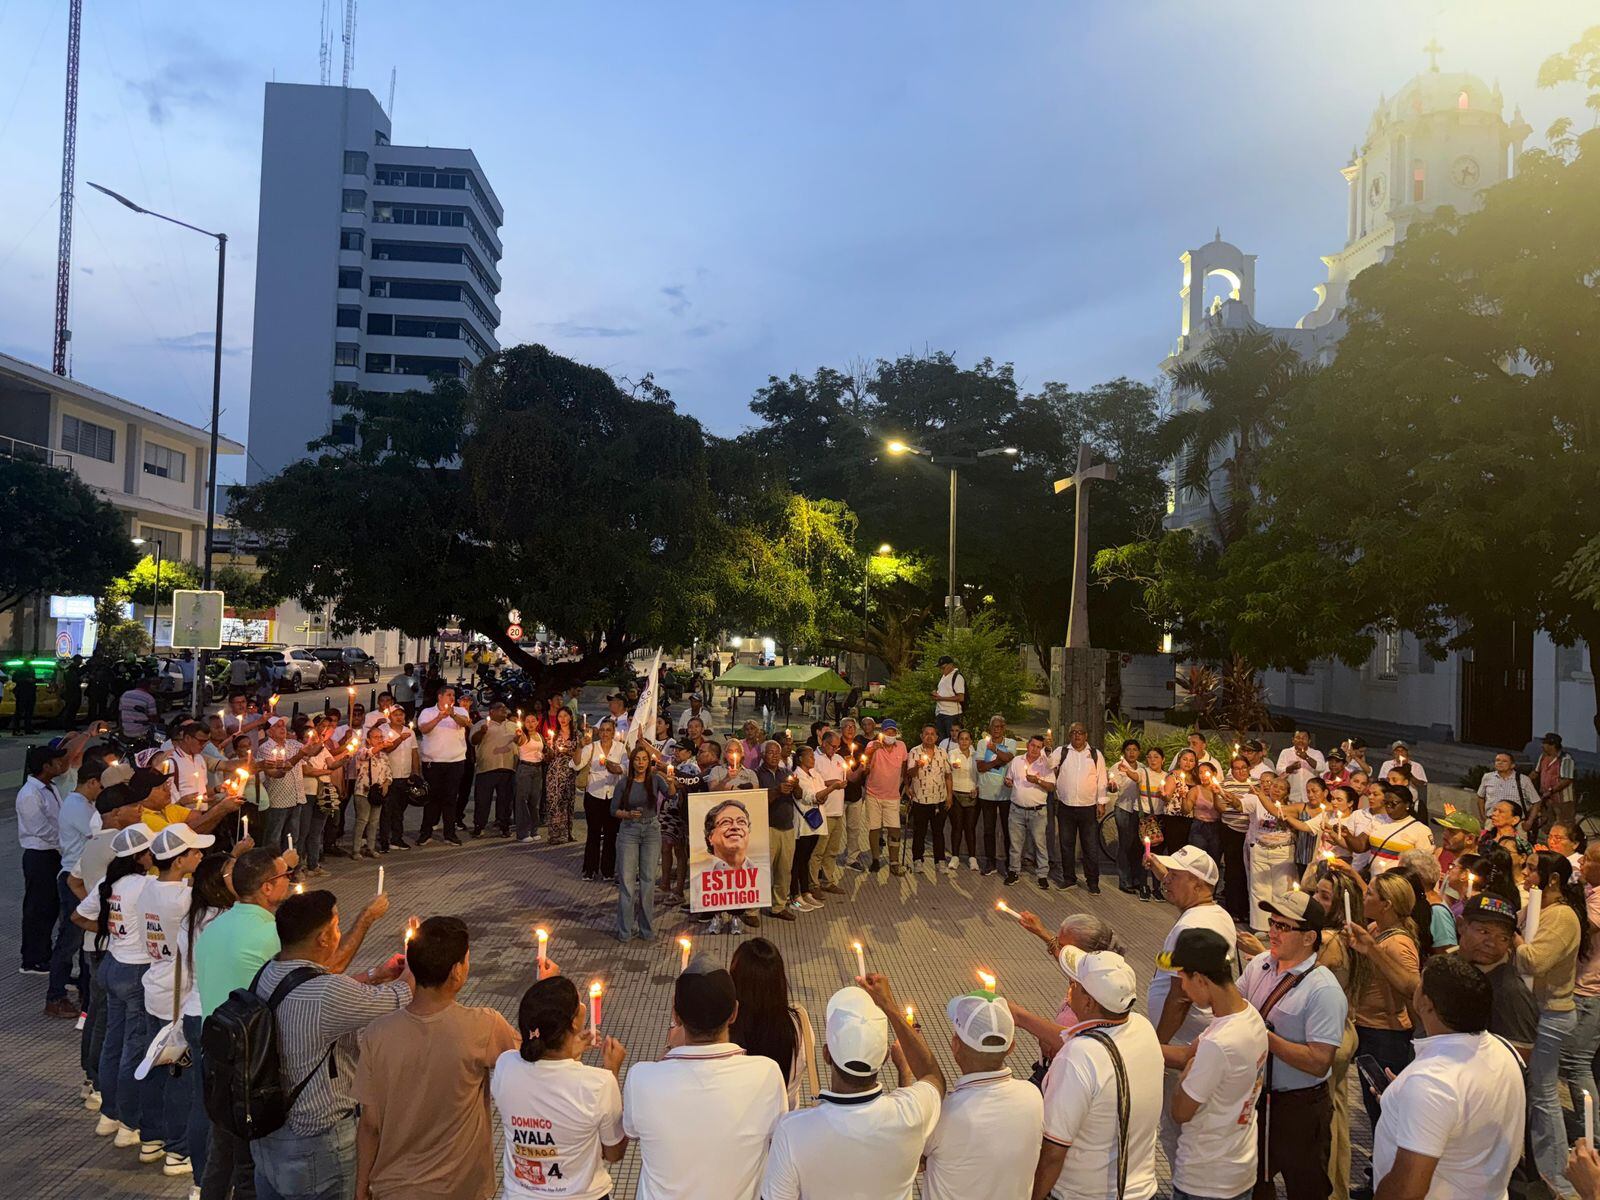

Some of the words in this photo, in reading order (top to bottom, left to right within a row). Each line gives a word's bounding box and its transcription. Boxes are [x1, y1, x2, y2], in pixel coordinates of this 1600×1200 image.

[510, 628, 519, 636] 20
[702, 868, 759, 892] ESTOY
[702, 890, 760, 907] CONTIGO!
[119, 924, 127, 935] 4
[162, 944, 171, 956] 4
[511, 1116, 552, 1129] DOMINGO
[513, 1129, 555, 1145] AYALA
[547, 1163, 563, 1179] 4
